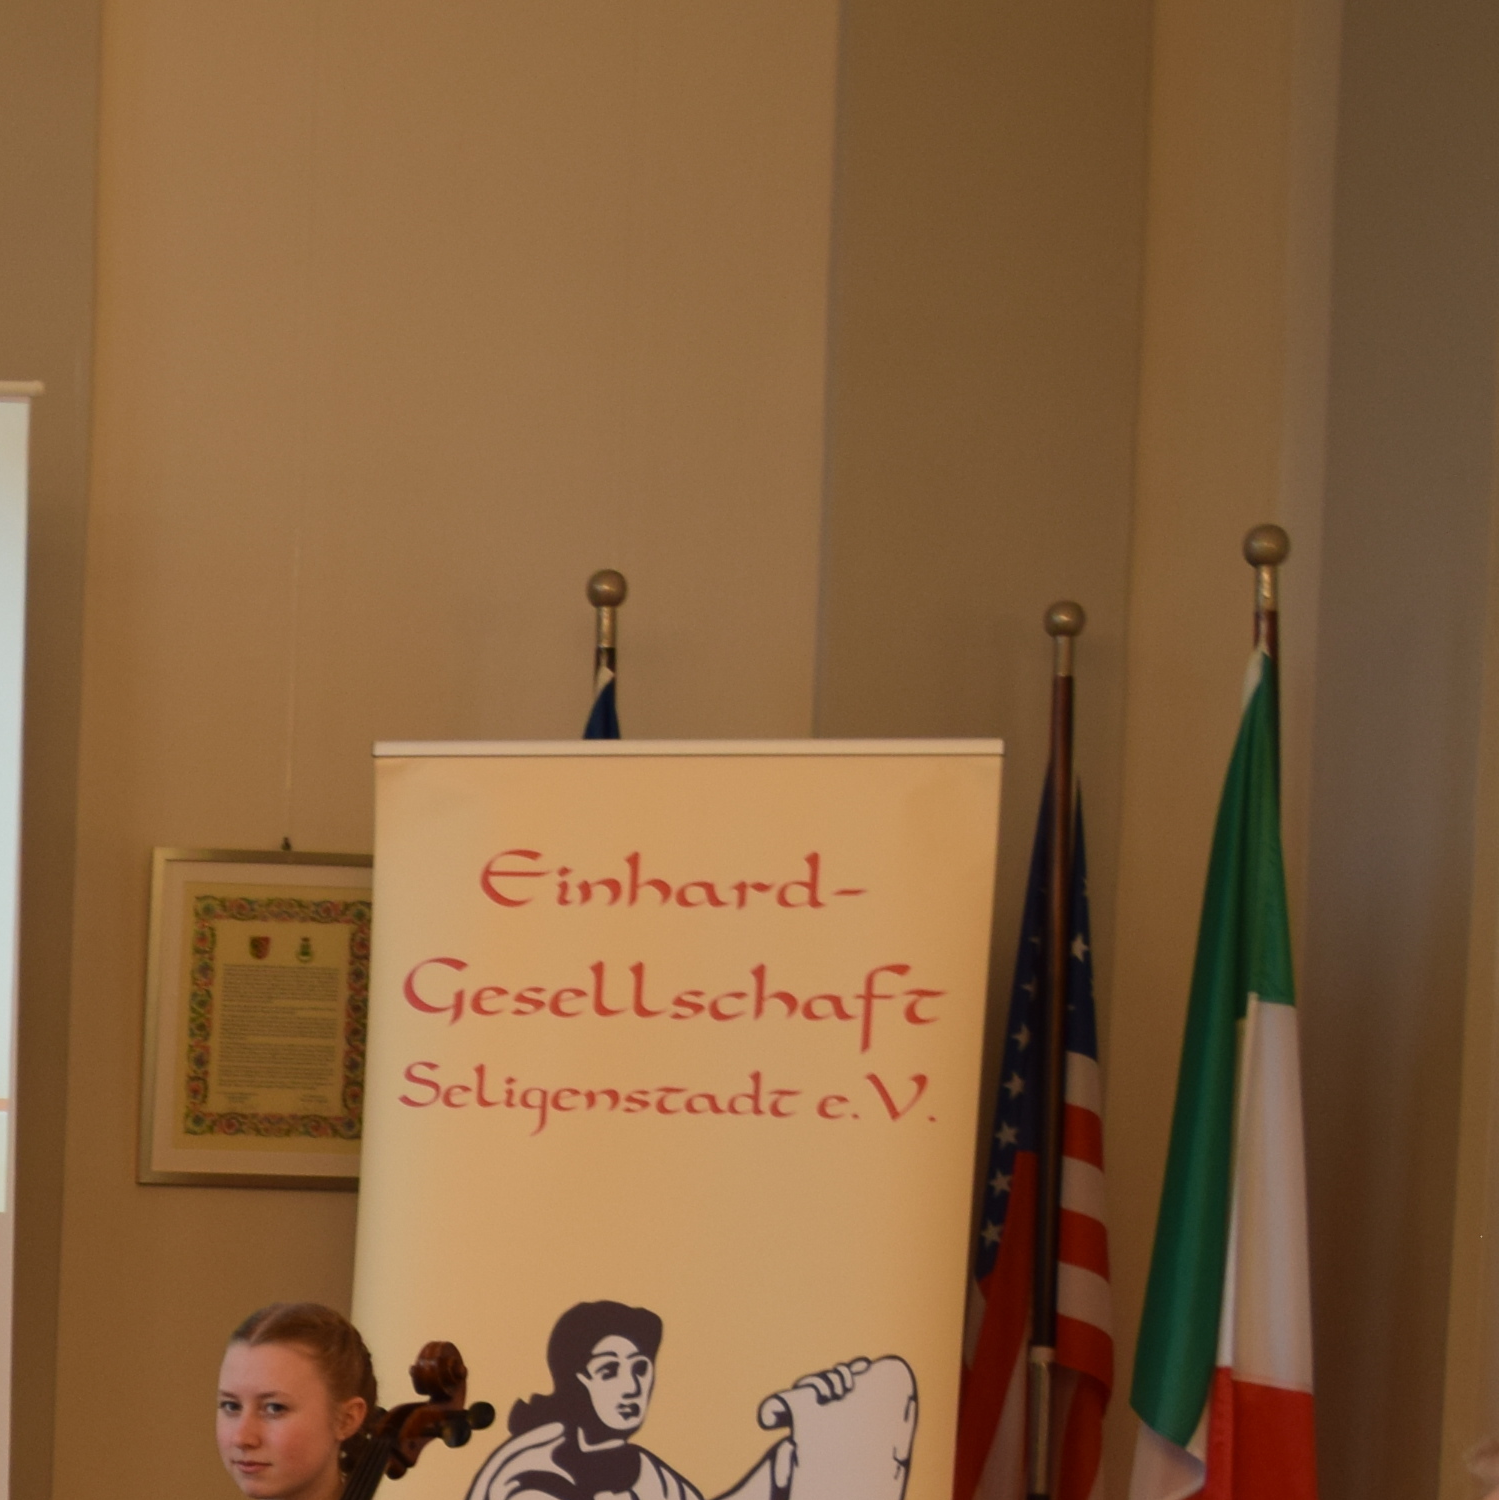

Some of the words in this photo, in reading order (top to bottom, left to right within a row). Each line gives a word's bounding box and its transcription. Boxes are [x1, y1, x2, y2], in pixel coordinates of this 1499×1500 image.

[479, 848, 867, 910] Einhard-
[402, 956, 948, 1054] Gesellschaft
[398, 1060, 800, 1136] Seligenstadt
